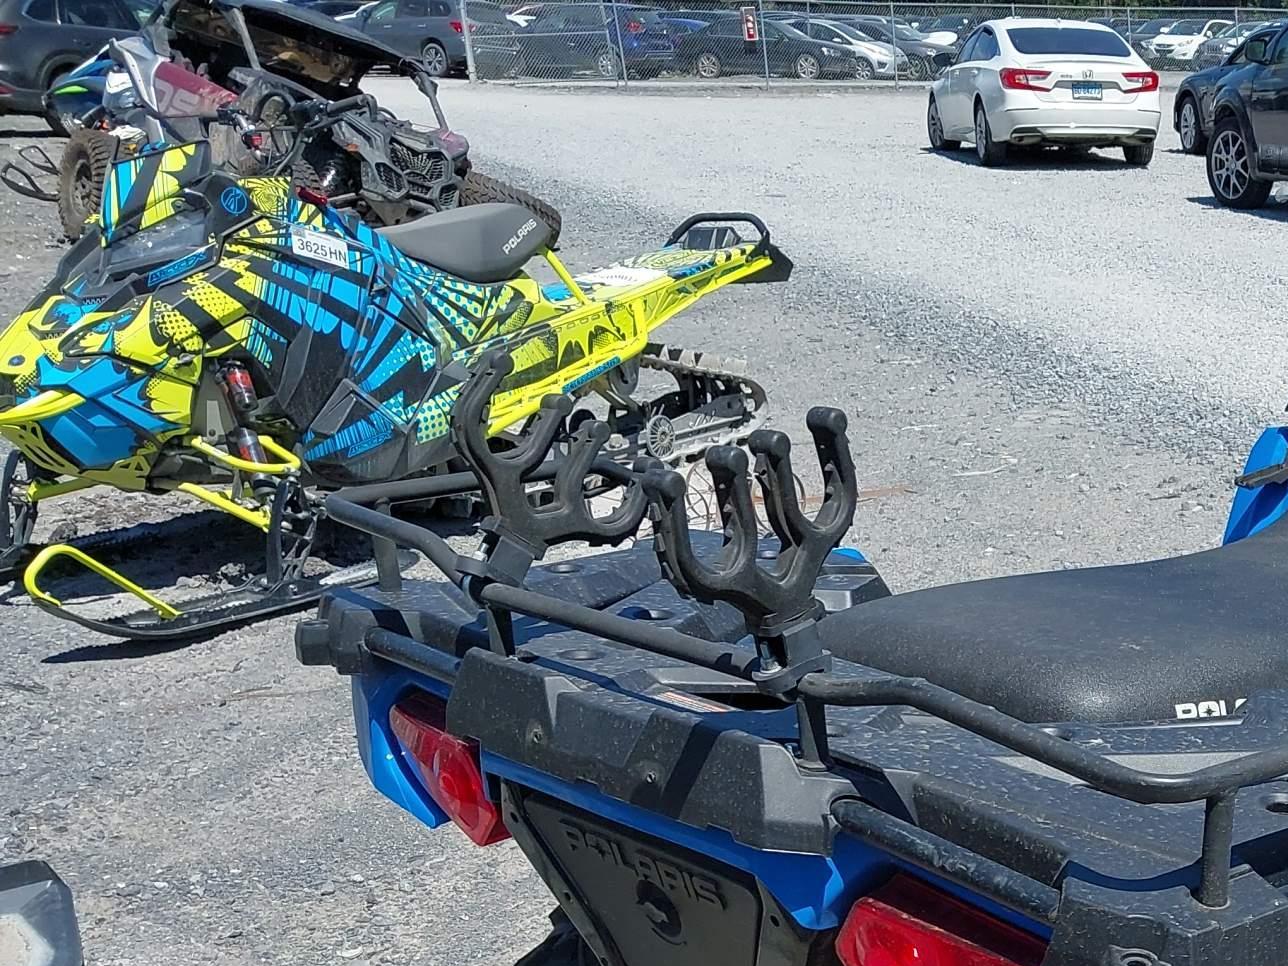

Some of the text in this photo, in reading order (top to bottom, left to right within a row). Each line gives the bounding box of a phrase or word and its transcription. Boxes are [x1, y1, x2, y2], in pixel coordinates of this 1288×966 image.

[297, 238, 347, 264] 3625HN
[502, 218, 537, 255] POLARIS
[558, 818, 727, 911] POLARIS
